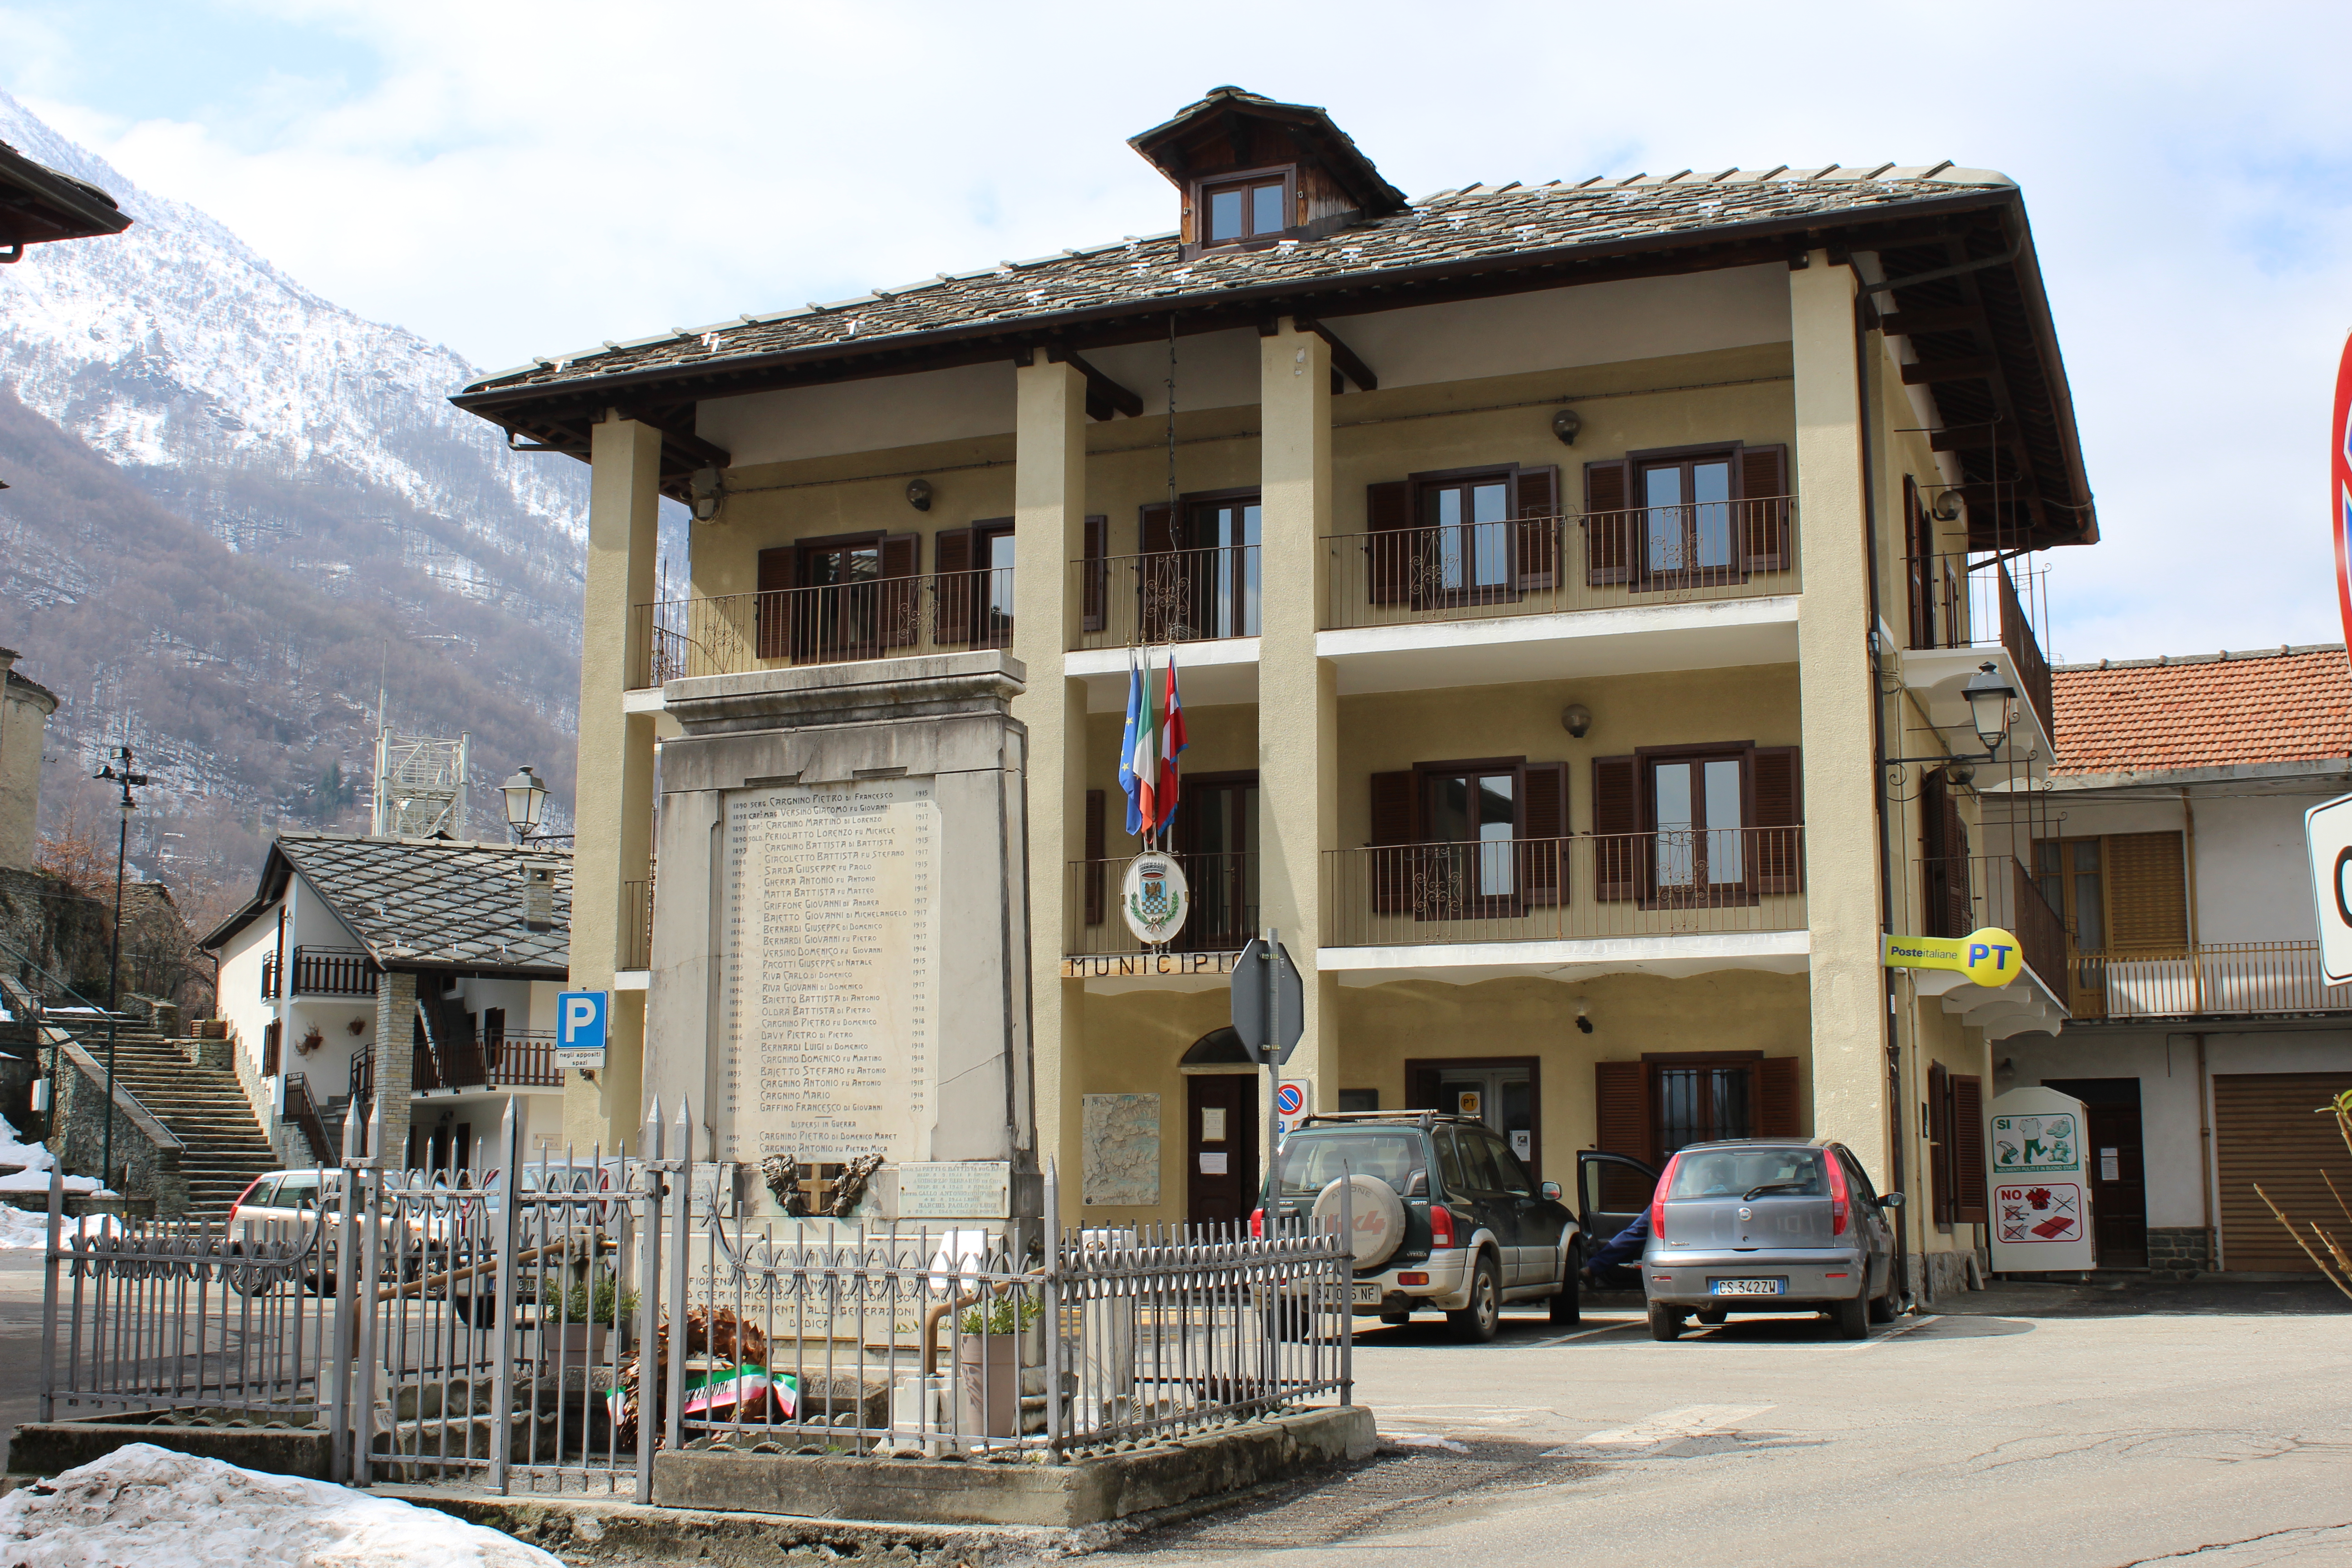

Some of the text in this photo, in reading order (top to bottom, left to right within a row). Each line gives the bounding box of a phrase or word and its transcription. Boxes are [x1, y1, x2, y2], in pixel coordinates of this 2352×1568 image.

[769, 797, 811, 807] CARGNINO
[813, 794, 843, 804] PIETRO
[855, 792, 893, 801] FRANCESCO
[780, 808, 812, 818] VERSINO
[813, 805, 848, 818] GIACOMO
[860, 804, 891, 812] GIOVANNI
[766, 820, 804, 830] CARGNINO
[805, 818, 842, 827] MARTINO
[765, 831, 814, 841] PERIOLATTO
[817, 828, 853, 838] LORENZO
[865, 827, 895, 836] MICHELE
[764, 843, 804, 853] CARGNINO
[806, 840, 846, 850] BATTISTA
[857, 839, 893, 847] BATTISTA
[764, 854, 815, 864] GIACOLETTO
[817, 851, 859, 861] BATTISTA
[871, 850, 905, 859] STEFANO
[764, 866, 794, 876] SARDA
[795, 864, 837, 874] GIUSEPPE
[764, 877, 796, 887] GHERRA
[799, 876, 834, 885] ANTONIO
[764, 889, 792, 899] MATTA
[794, 887, 835, 897] BATTISTA
[764, 901, 803, 911] GRIFFONE
[805, 899, 841, 909] GIOVANNI
[805, 911, 844, 920] GIOVANNI
[854, 910, 907, 919] MICHELANGELO
[763, 925, 801, 935] BERNARDI
[804, 922, 841, 933] GIUSEPPE
[763, 948, 796, 959] VERSINO
[798, 947, 838, 957] DOMENICO
[1969, 944, 2012, 970] PT
[763, 960, 796, 970] PACOTTI
[798, 958, 836, 969] GIUSEPPE
[845, 958, 872, 966] NATALE
[763, 971, 781, 980] RIVA
[783, 970, 809, 982] CARLO
[819, 971, 853, 980] DOMENICO
[799, 994, 840, 1004] BATTISTA
[793, 1006, 835, 1016] BATTISTA
[846, 1006, 871, 1014] PIETRO
[566, 998, 597, 1042] P
[761, 1019, 799, 1029] CARGNINO
[801, 1018, 831, 1028] PIETRO
[761, 1031, 784, 1040] DAVY
[787, 1029, 817, 1039] PIETRO
[828, 1031, 853, 1039] PIETRO
[761, 1042, 801, 1053] BERNARDI
[804, 1041, 824, 1051] LUIGI
[761, 1054, 799, 1064] CARGNINO
[801, 1054, 841, 1063] DOMENICO
[852, 1054, 882, 1062] MARTINO
[802, 1065, 845, 1077] STEFANO
[857, 1066, 886, 1074] ANTONIO
[760, 1090, 830, 1102] CARGNINO MARIO
[760, 1102, 794, 1112] GAFFINO
[796, 1102, 842, 1114] FRANCESCO
[853, 1103, 882, 1111] GIOVANNI
[1463, 1098, 1475, 1107] PT
[791, 1121, 819, 1129] DISPERSI
[831, 1120, 856, 1129] GUERRA
[1997, 1119, 2010, 1130] SI
[759, 1131, 797, 1142] CARGNINO
[799, 1131, 829, 1141] PIETRO
[840, 1132, 872, 1141] DOMENICO
[874, 1132, 897, 1141] MARET
[759, 1143, 796, 1153] CARGNINO
[798, 1142, 833, 1152] ANTONIO
[845, 1144, 868, 1153] PIETRO
[870, 1144, 888, 1153] MICA
[2001, 1190, 2022, 1200] NO
[1720, 1281, 1775, 1293] CS 342ZW
